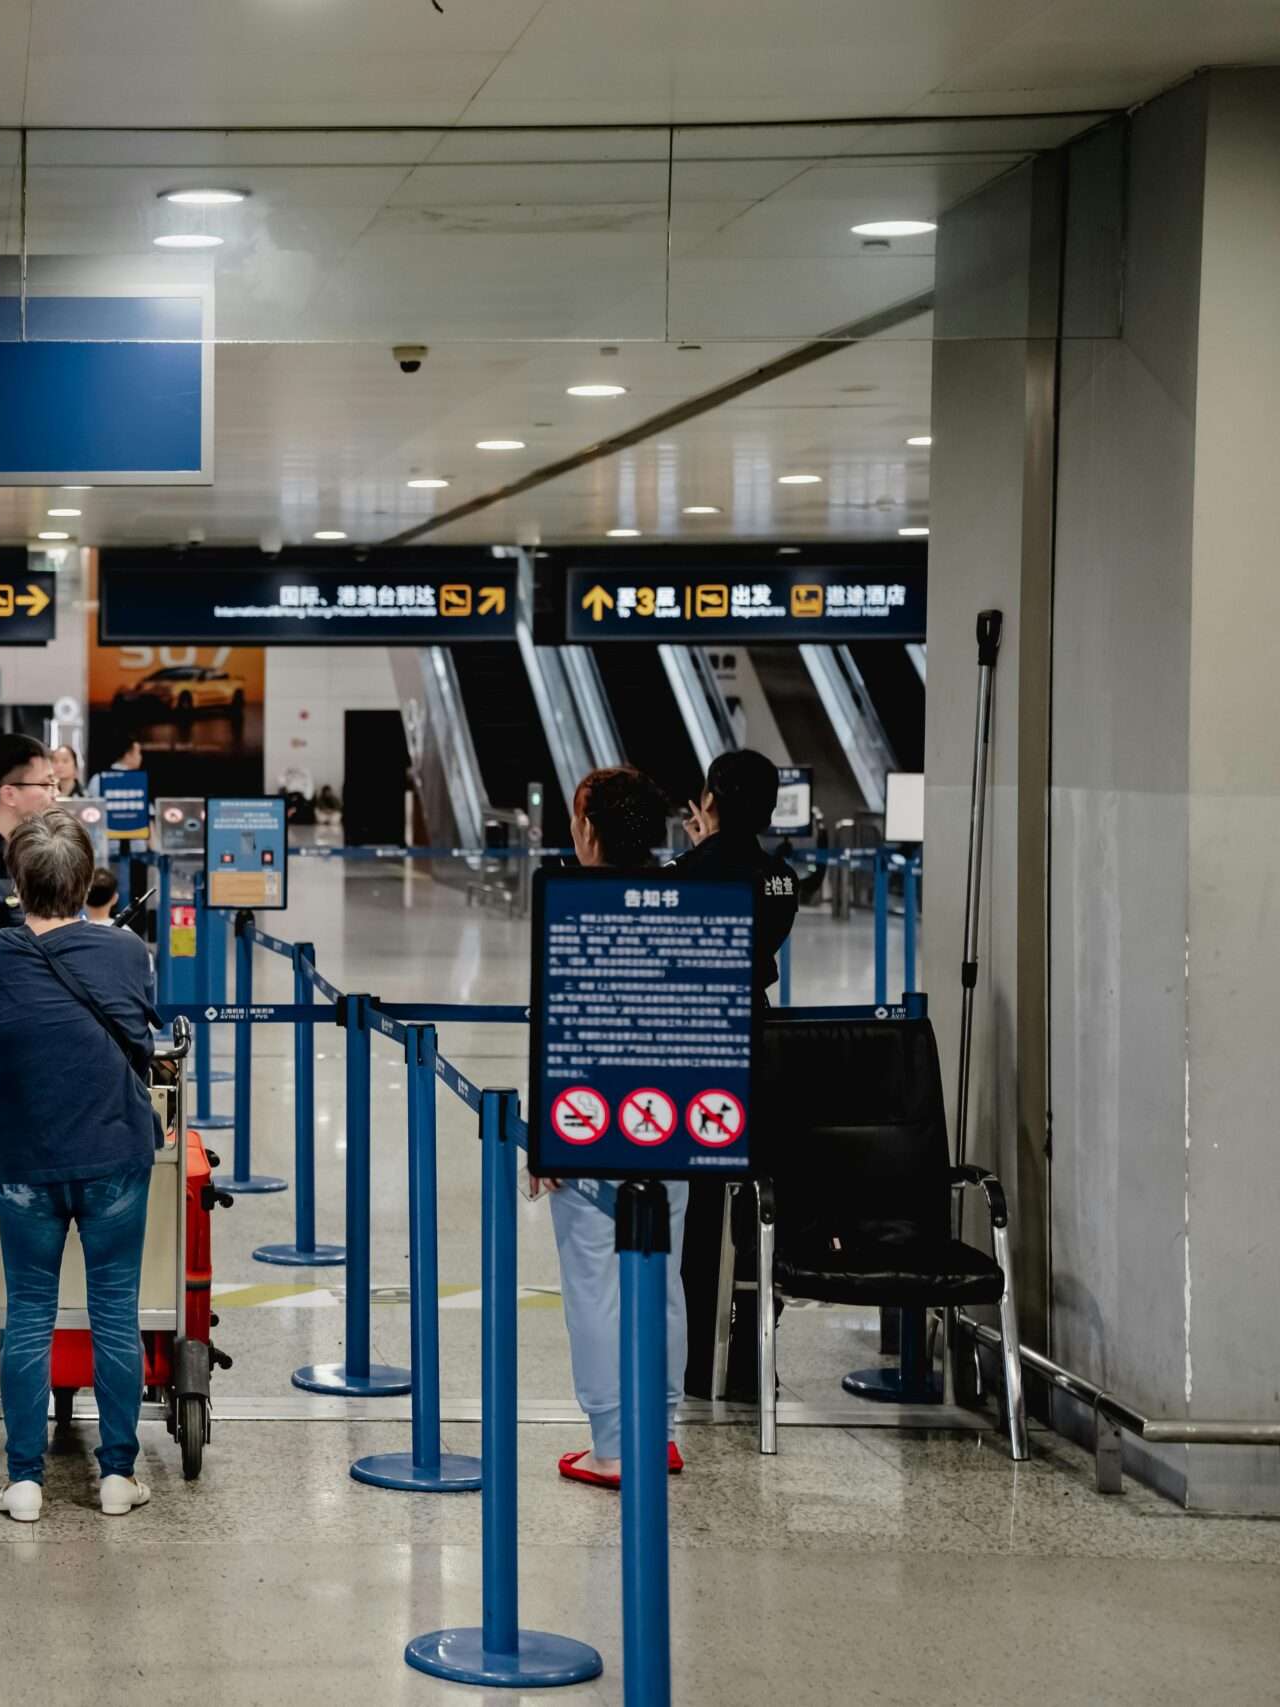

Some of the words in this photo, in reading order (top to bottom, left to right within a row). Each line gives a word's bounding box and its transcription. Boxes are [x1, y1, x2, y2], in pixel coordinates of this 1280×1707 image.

[731, 584, 771, 606] 出发
[624, 889, 679, 908] 告知书
